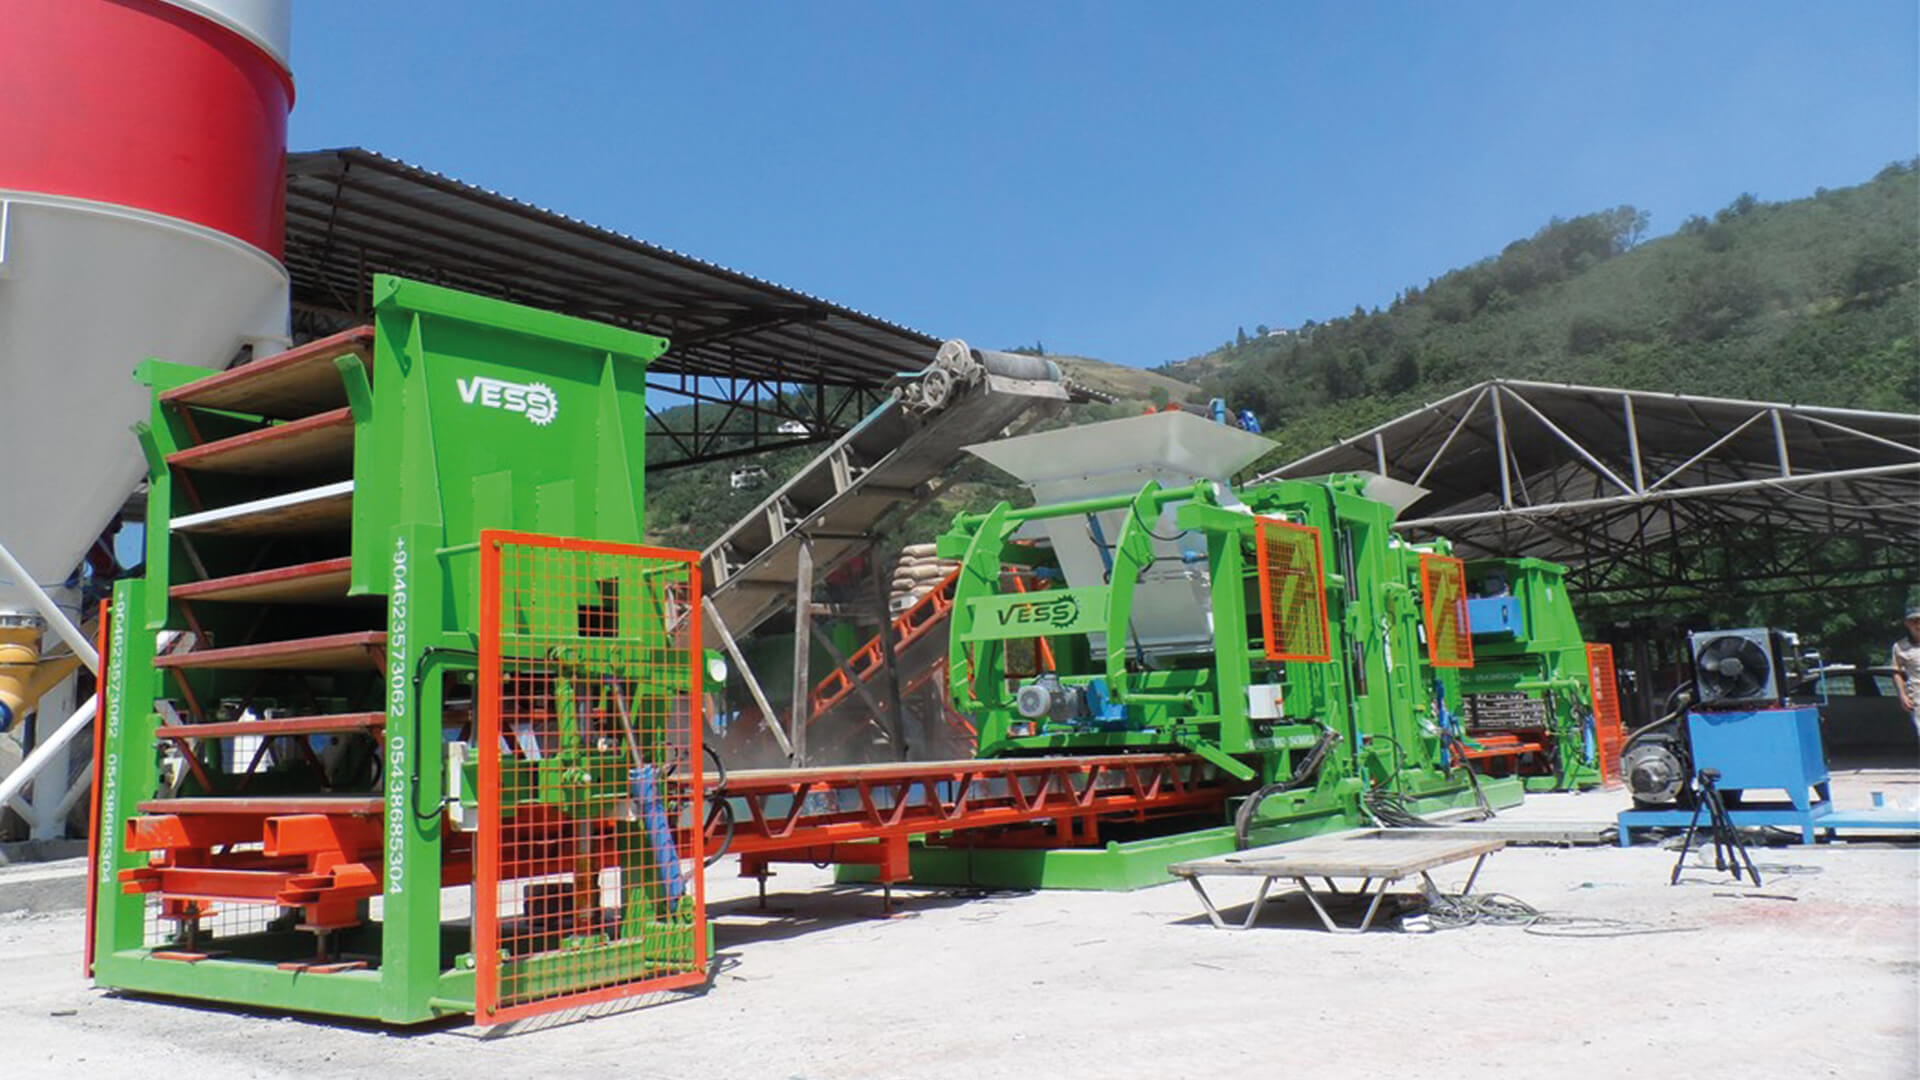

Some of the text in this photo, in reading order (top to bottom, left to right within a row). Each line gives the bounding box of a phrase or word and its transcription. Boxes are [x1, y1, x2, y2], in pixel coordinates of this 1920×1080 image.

[456, 375, 558, 427] VESS
[391, 536, 407, 717] +904623573062
[997, 594, 1079, 628] VESS
[389, 736, 404, 893] 05438685304
